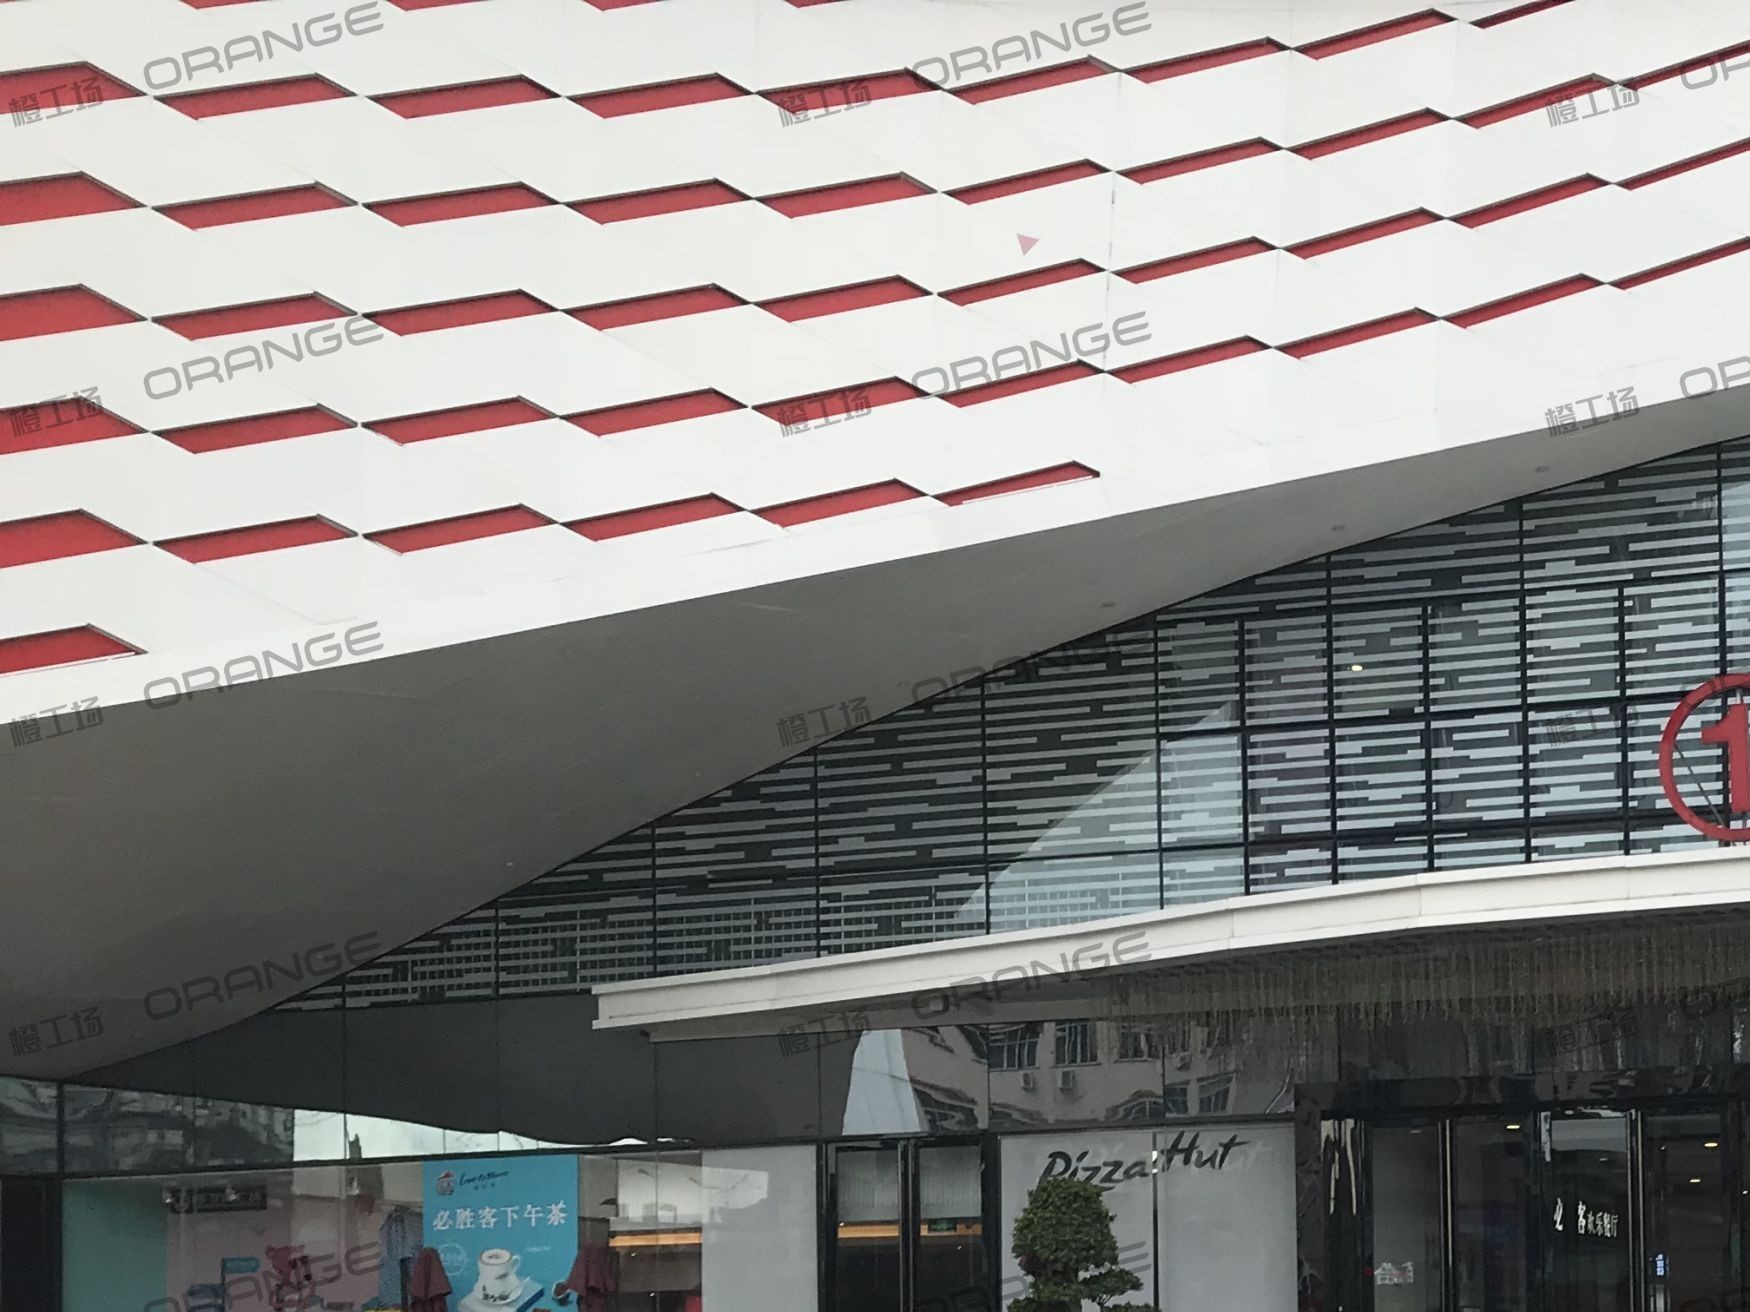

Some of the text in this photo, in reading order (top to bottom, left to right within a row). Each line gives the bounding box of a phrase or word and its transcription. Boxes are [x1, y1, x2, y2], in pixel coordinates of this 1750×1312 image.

[1036, 1130, 1250, 1193] Pizza Hut
[432, 1200, 568, 1231] 必胜客下午茶
